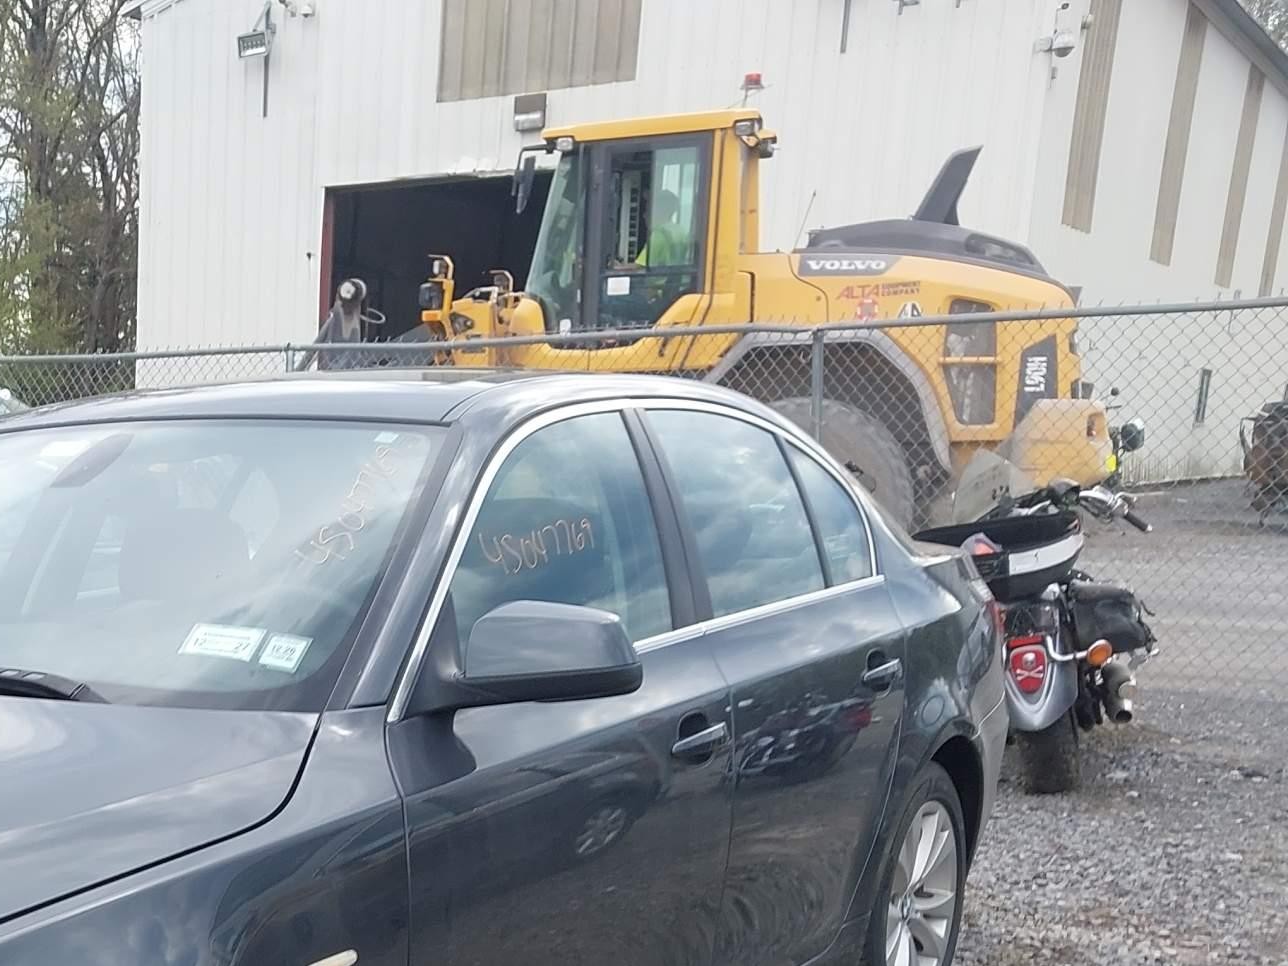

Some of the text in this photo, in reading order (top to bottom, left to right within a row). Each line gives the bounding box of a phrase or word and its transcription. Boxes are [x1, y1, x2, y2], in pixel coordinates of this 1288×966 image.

[807, 260, 887, 270] VOLVO
[836, 284, 880, 300] ALTA
[1023, 356, 1048, 392] L90H
